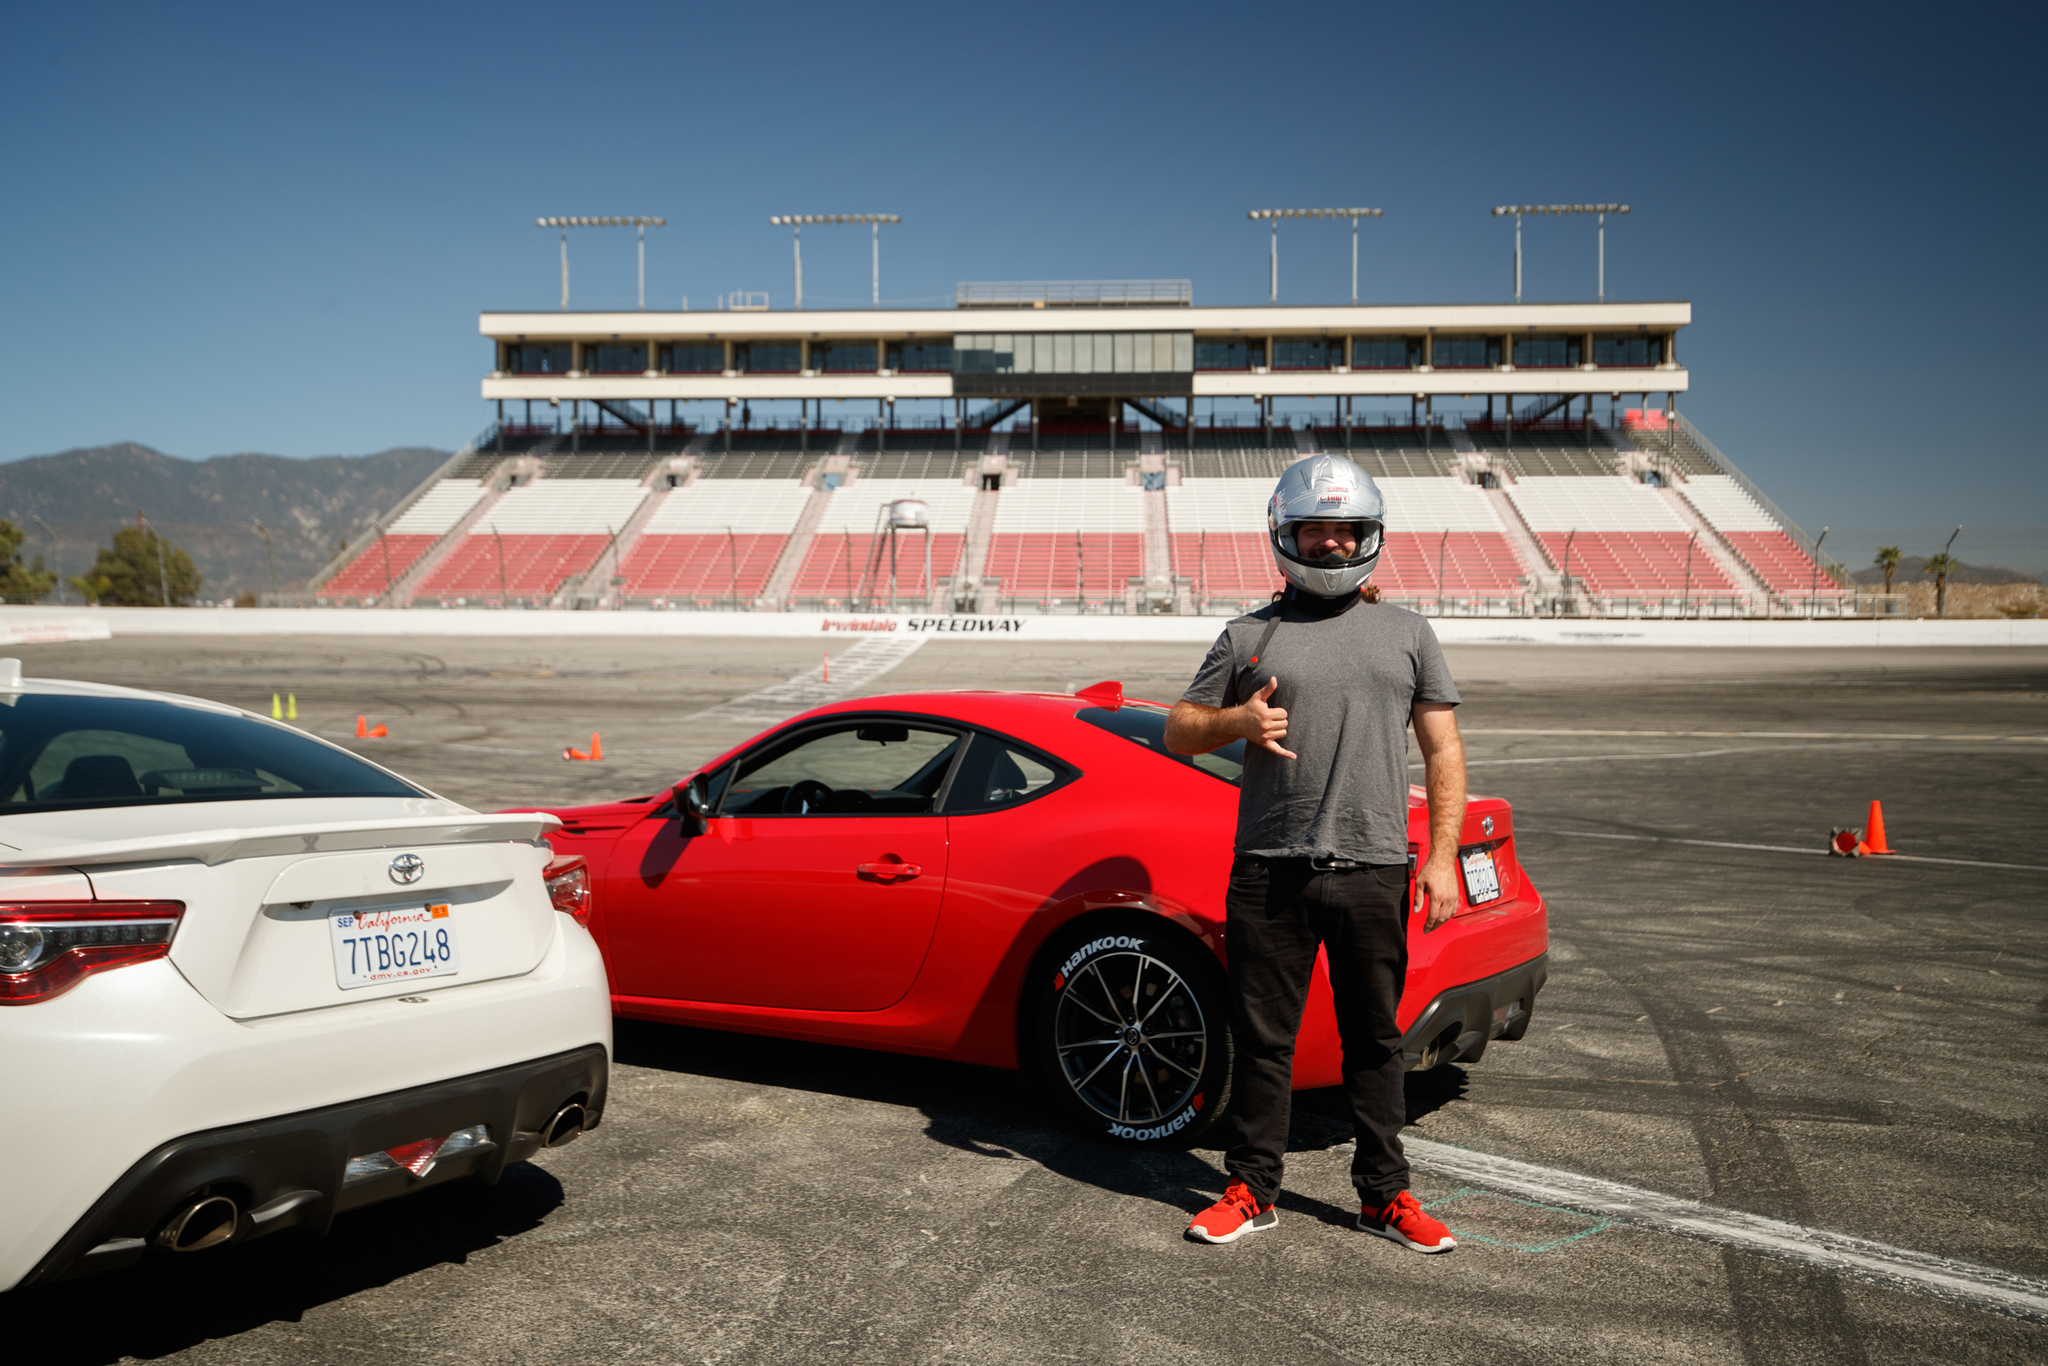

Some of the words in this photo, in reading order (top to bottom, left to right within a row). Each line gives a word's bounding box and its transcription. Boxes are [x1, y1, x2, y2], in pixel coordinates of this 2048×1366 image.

[908, 618, 1026, 632] SPEEDWAY
[337, 916, 354, 928] SEP
[358, 908, 432, 932] California
[343, 928, 450, 974] 7TBG248
[370, 967, 432, 980] dmv.ca.gov
